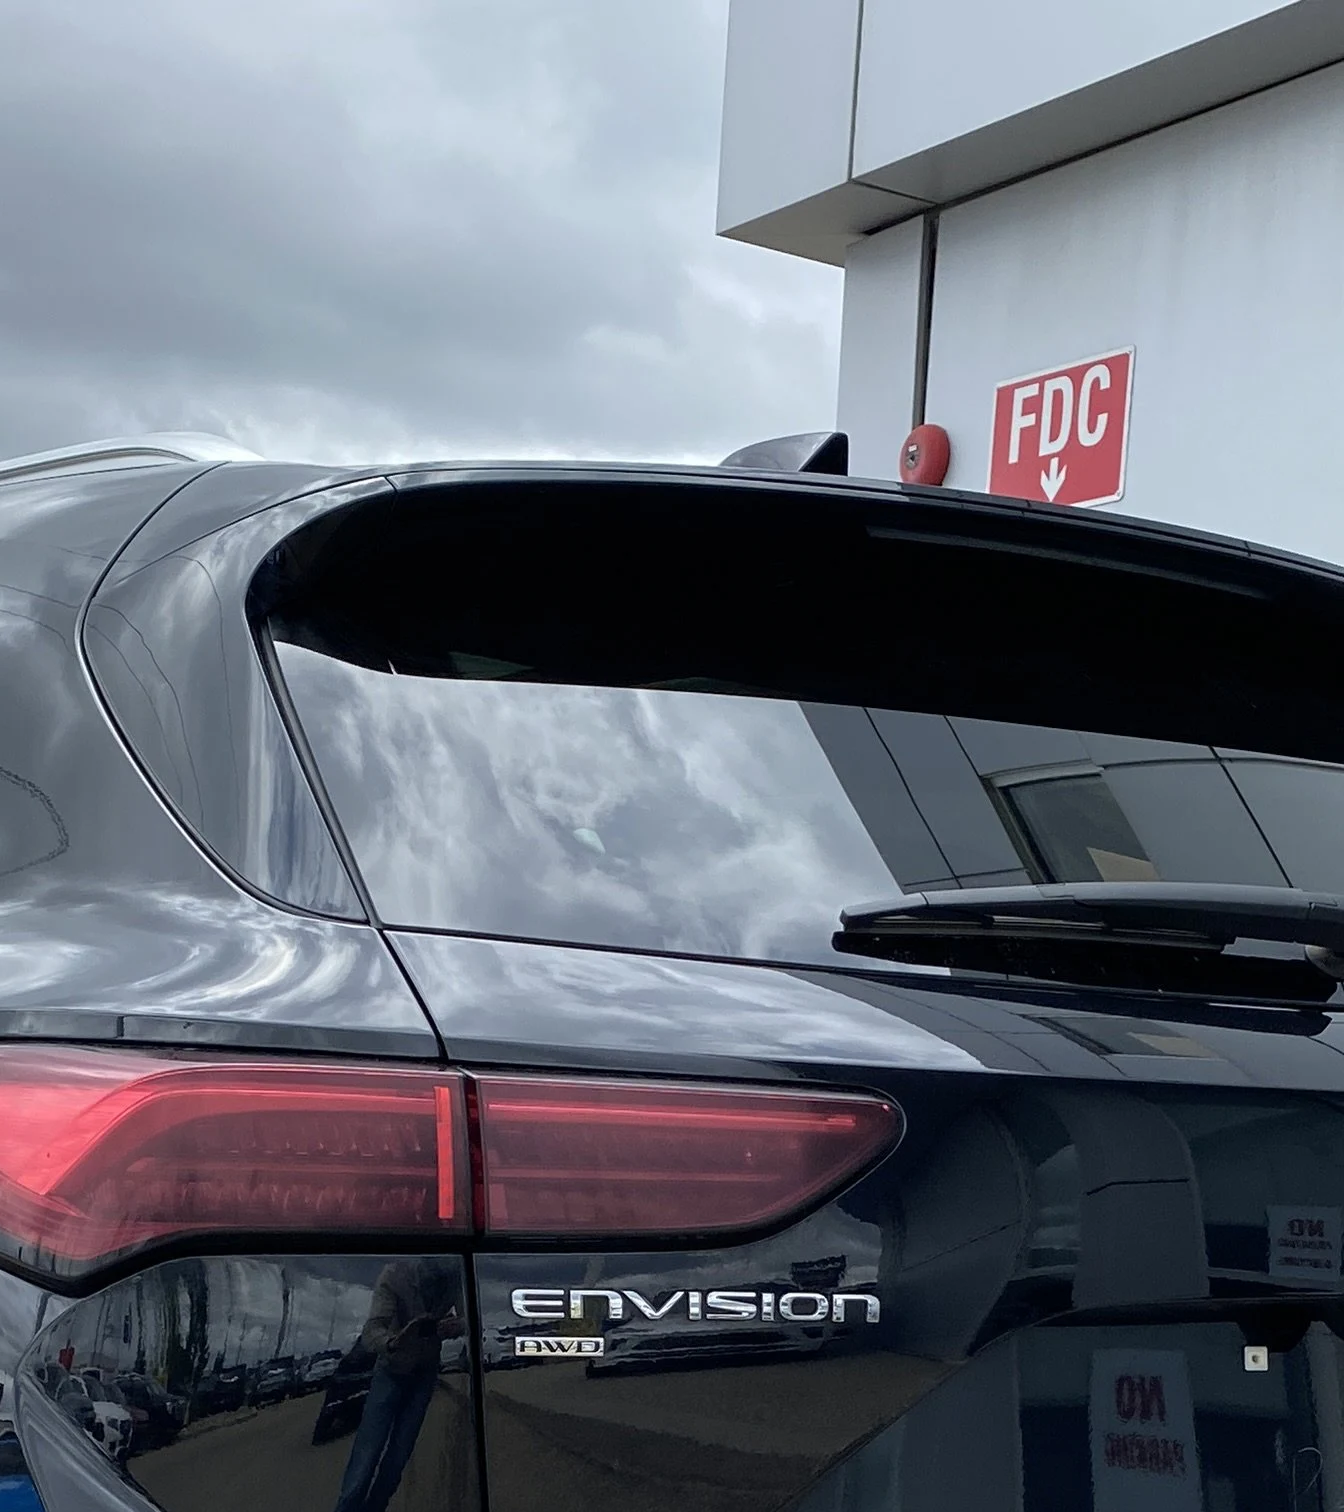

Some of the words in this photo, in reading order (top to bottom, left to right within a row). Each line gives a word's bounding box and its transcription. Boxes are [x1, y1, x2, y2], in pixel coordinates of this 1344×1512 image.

[1008, 363, 1111, 464] FDC
[511, 1288, 881, 1324] ENVISION
[518, 1340, 602, 1354] AWD
